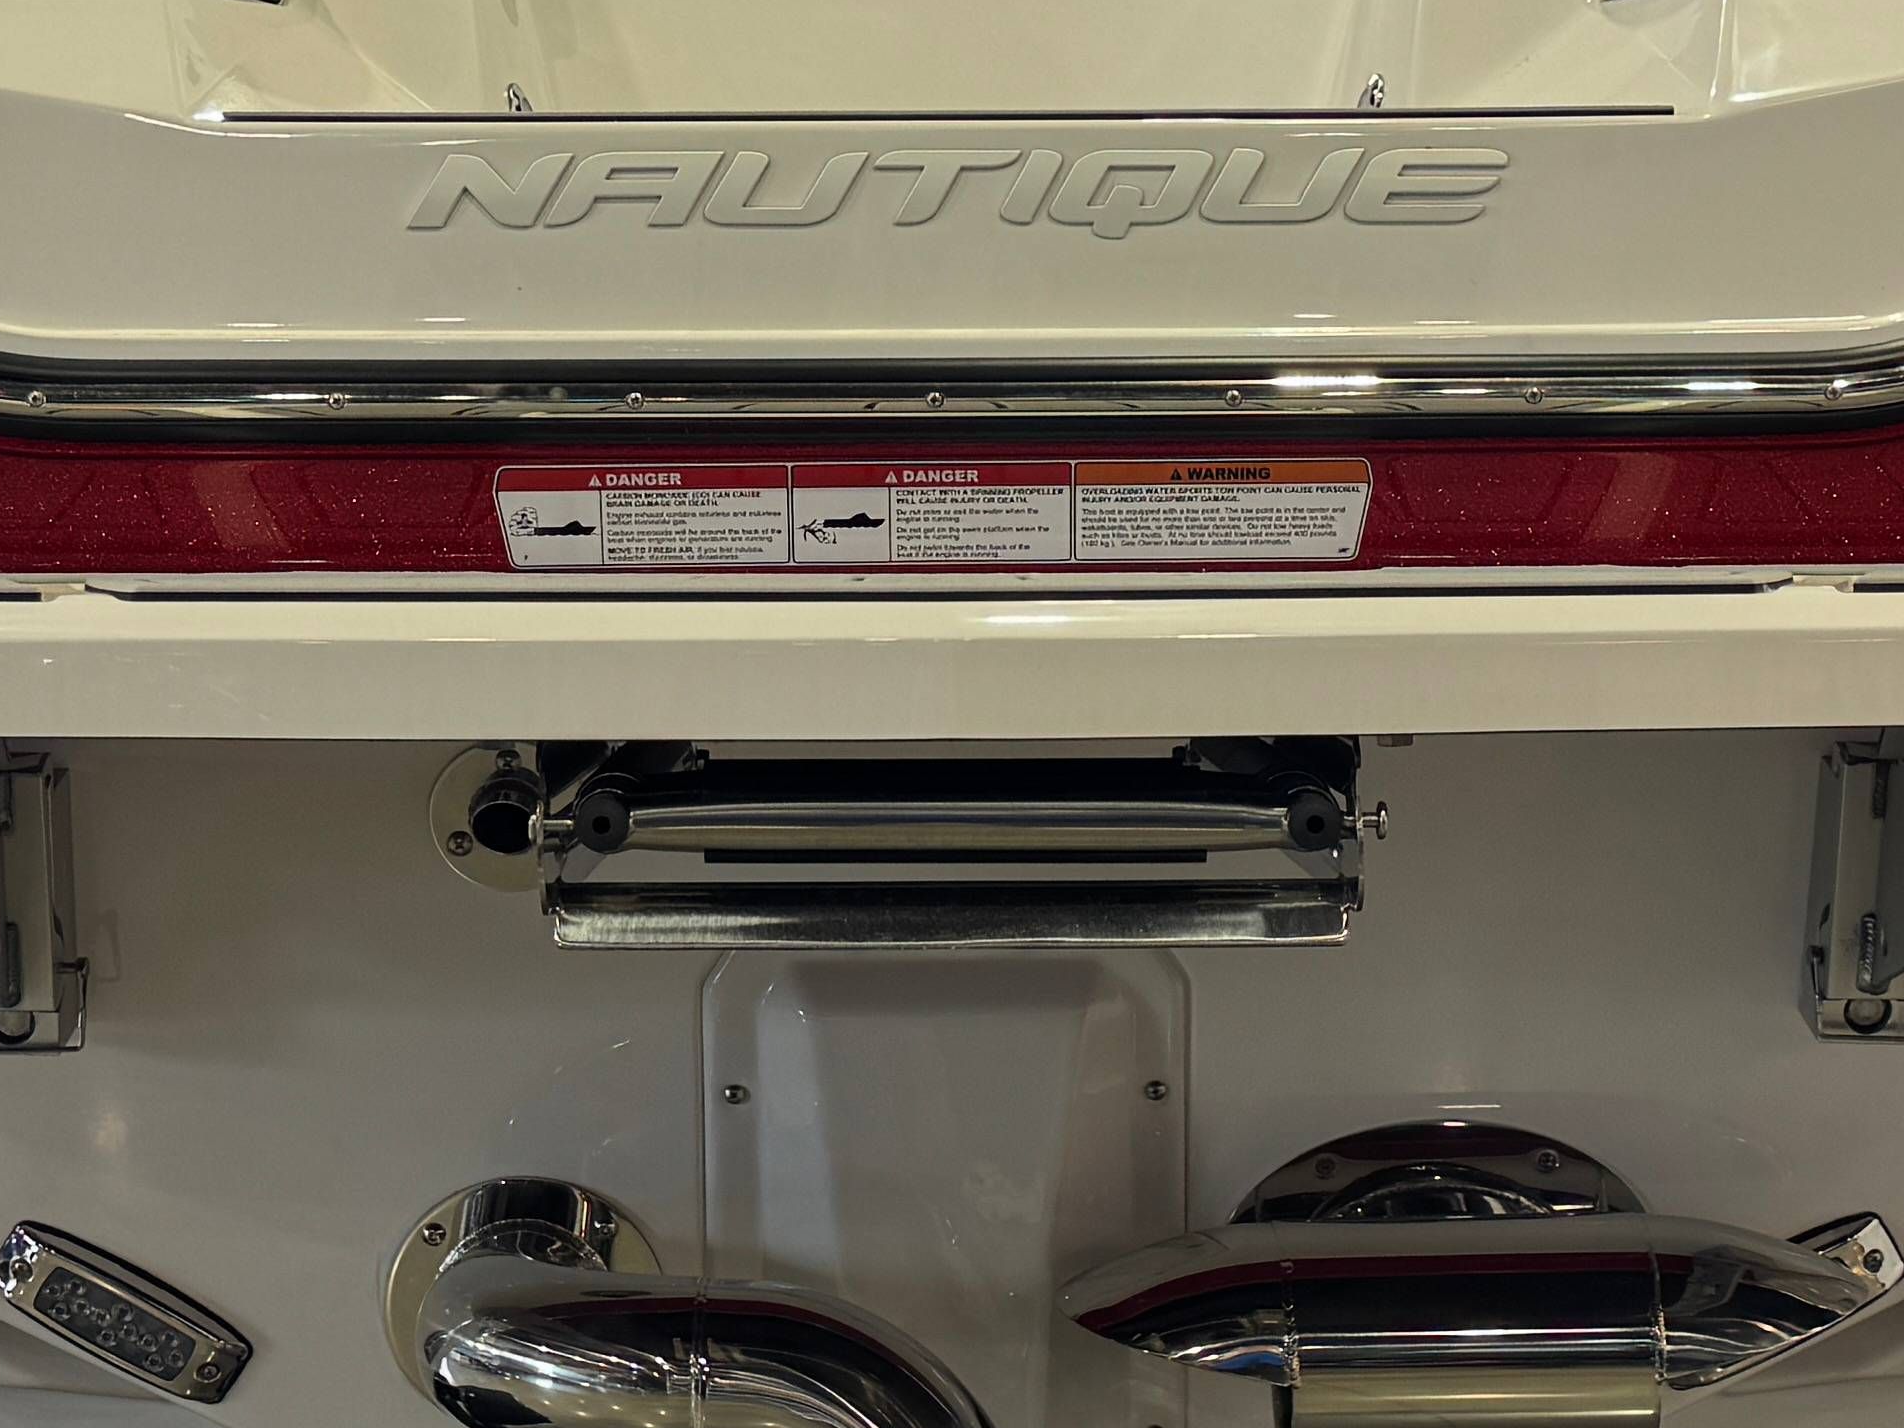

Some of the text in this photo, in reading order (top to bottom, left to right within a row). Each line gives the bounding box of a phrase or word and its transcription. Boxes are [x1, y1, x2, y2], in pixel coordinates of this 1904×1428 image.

[404, 146, 1510, 240] NAUTIQUE
[606, 473, 682, 486] DANGER
[902, 470, 979, 483] DANGER
[1187, 467, 1271, 481] WARNING
